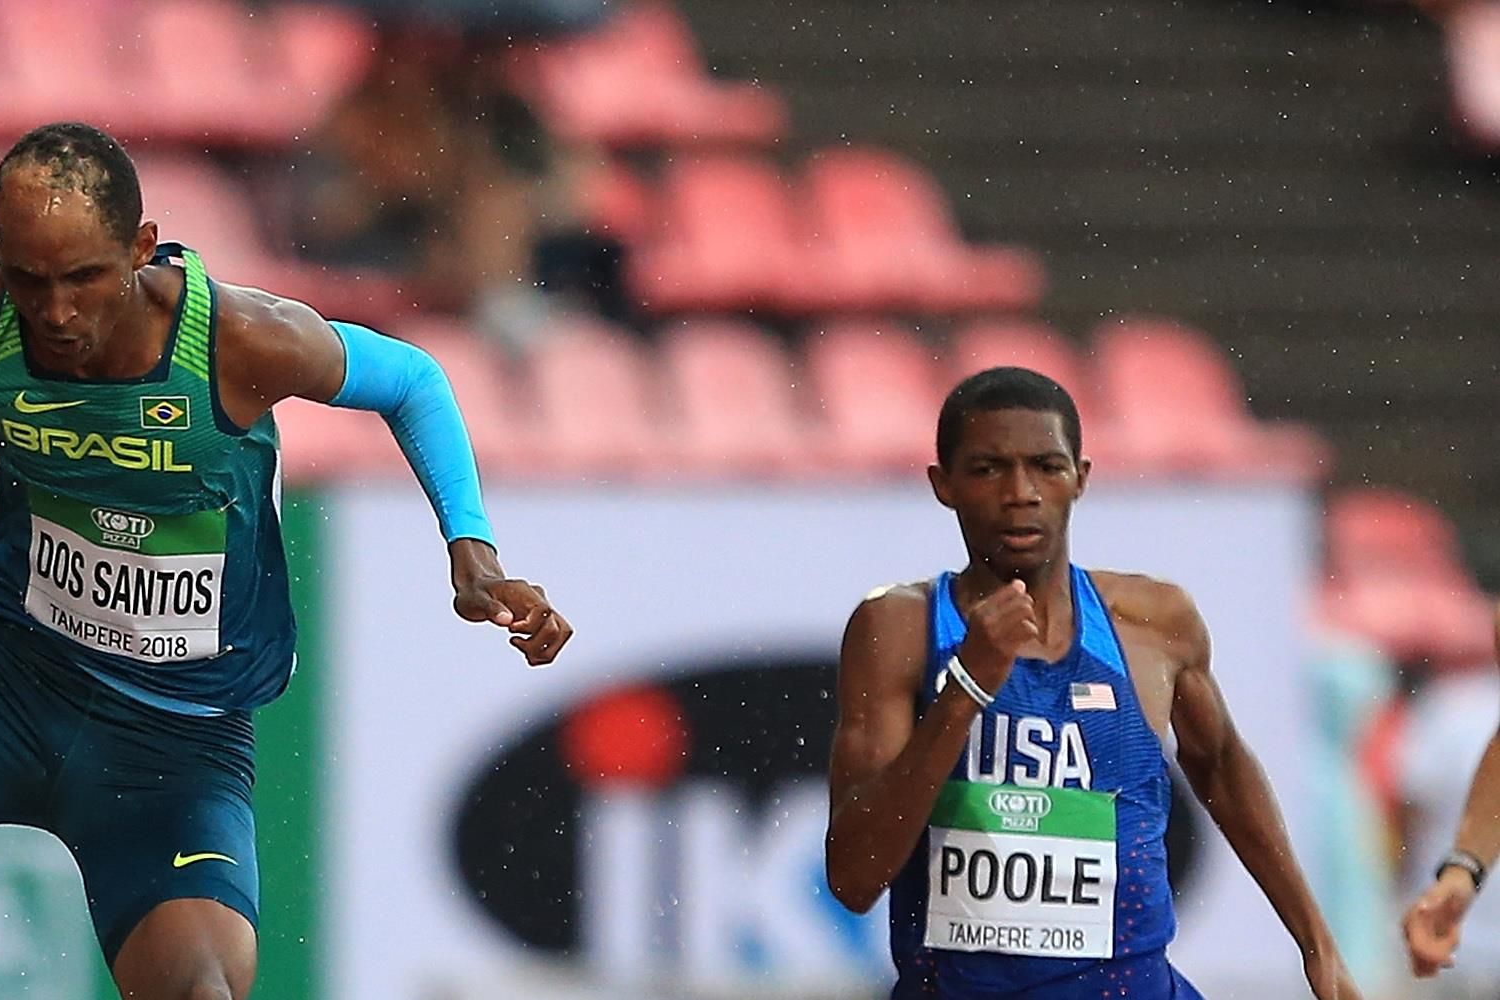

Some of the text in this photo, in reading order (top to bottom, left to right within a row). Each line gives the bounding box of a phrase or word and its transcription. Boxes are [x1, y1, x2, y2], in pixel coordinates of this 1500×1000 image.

[2, 419, 192, 472] BRASIL
[98, 510, 147, 534] KOTI
[102, 533, 137, 546] PIZZA
[36, 531, 213, 616] DOS SANTOS
[50, 604, 188, 658] TAMPERE 2018
[967, 713, 1091, 791] USA
[992, 795, 1046, 815] KOTI
[940, 846, 1100, 905] POOLE
[949, 923, 1085, 949] TAMPERE 2018
